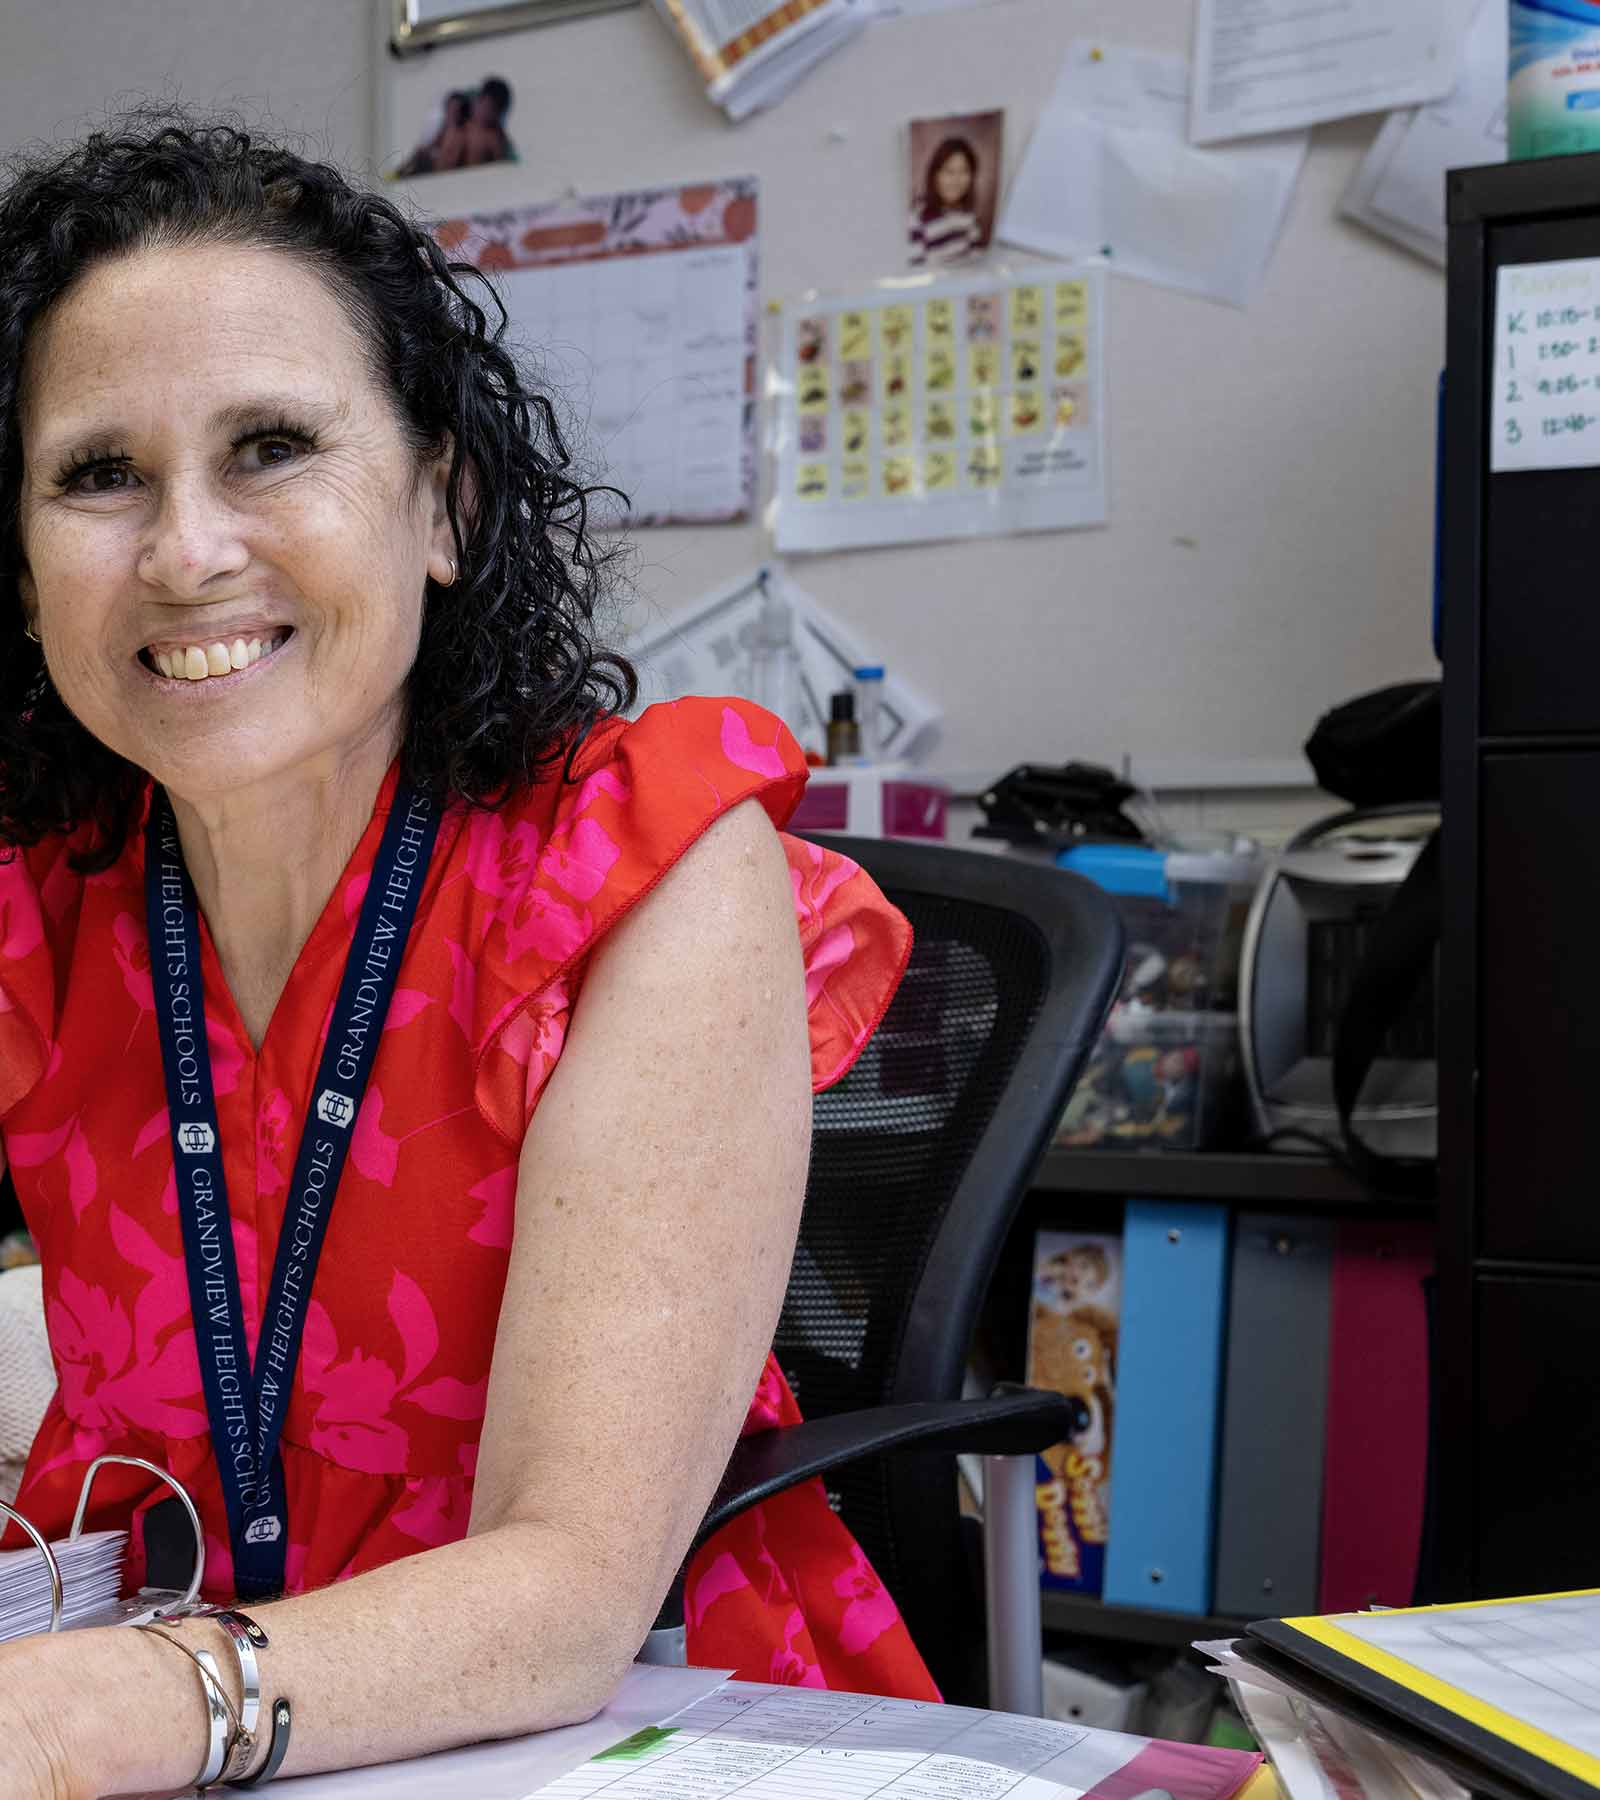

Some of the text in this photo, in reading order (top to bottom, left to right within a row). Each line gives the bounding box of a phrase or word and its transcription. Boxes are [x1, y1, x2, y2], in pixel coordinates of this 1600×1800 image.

[161, 864, 187, 977] HEIGHTS
[336, 796, 431, 1080] GRANDVIEW HEIGHTS
[169, 983, 201, 1105] SCHOOLS
[190, 1167, 230, 1327] GRANDVIEW
[212, 1333, 248, 1437] HEIGHTS
[267, 1262, 304, 1372] HEIGHTS
[292, 1138, 334, 1261] SCHOOLS
